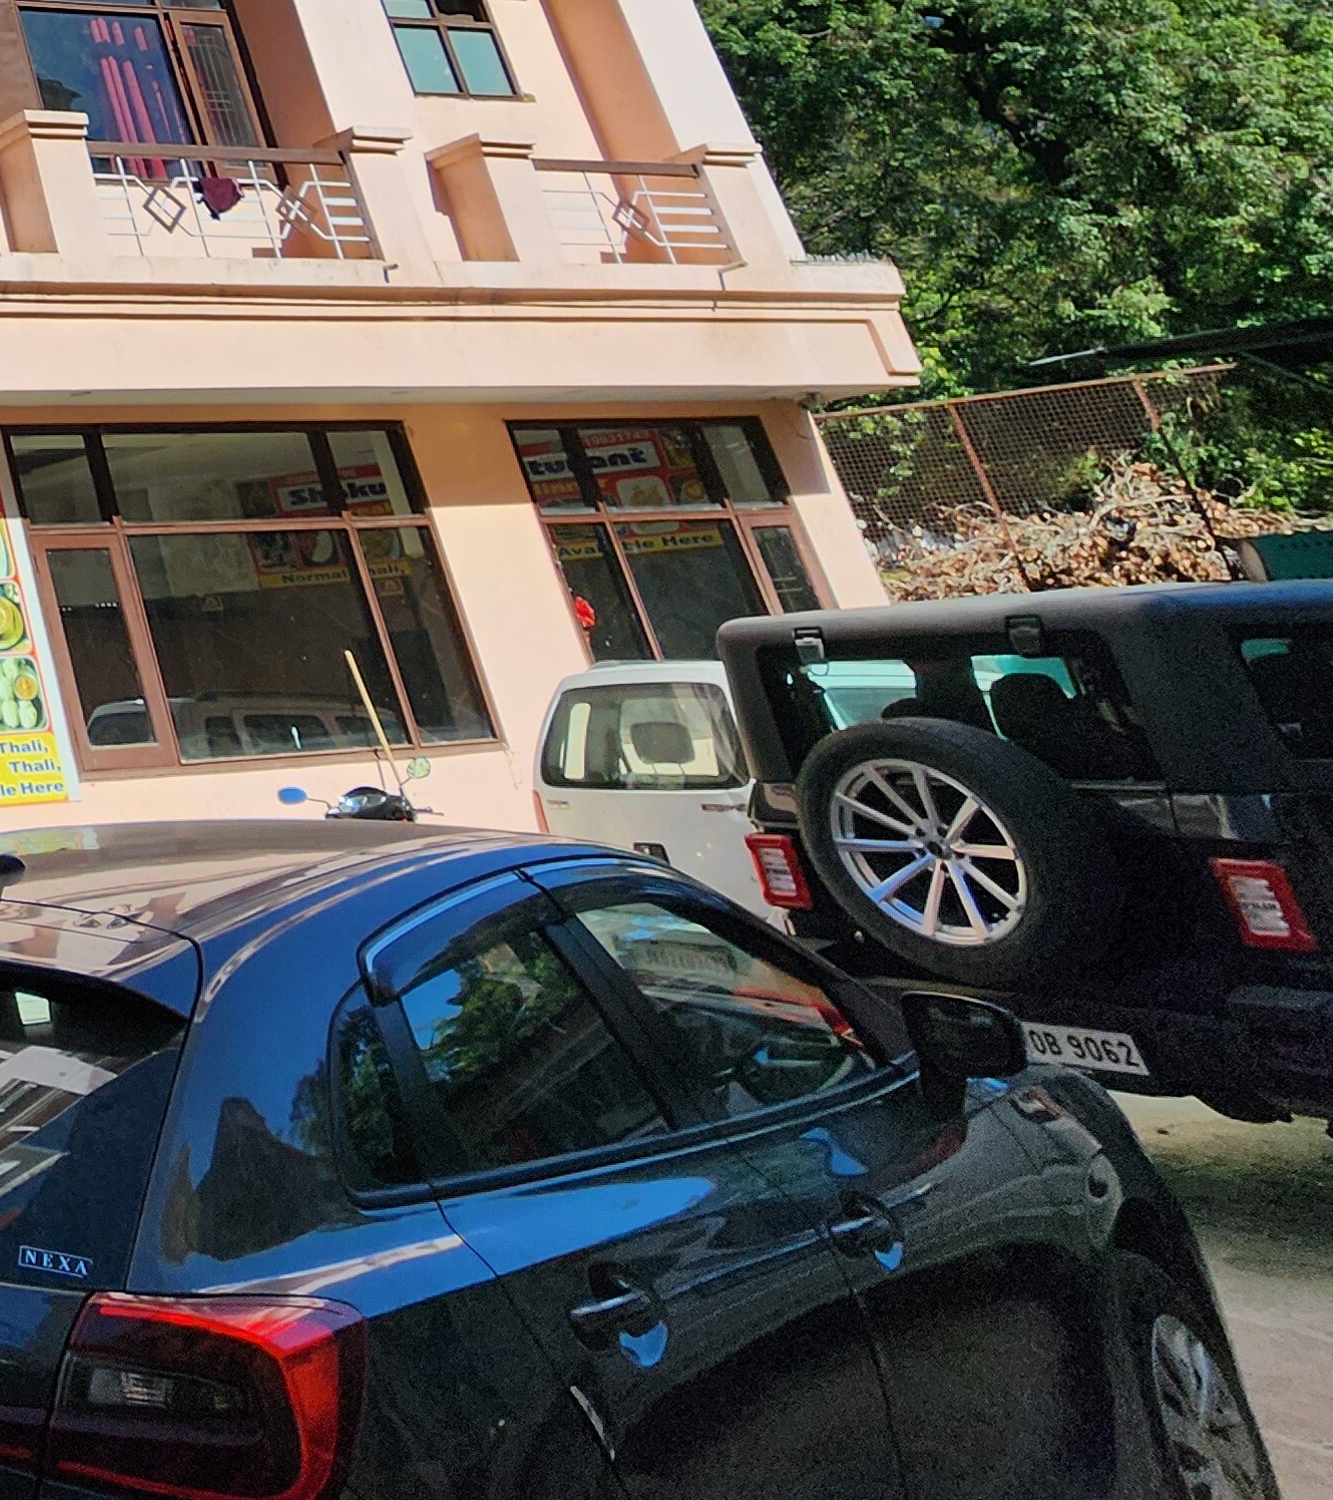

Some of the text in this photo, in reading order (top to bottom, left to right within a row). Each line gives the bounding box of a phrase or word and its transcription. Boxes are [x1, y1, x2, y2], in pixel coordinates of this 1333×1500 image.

[9, 758, 62, 774] Thali,
[20, 781, 64, 795] Here
[1066, 1034, 1140, 1067] 9062
[25, 1249, 88, 1276] NEXA
